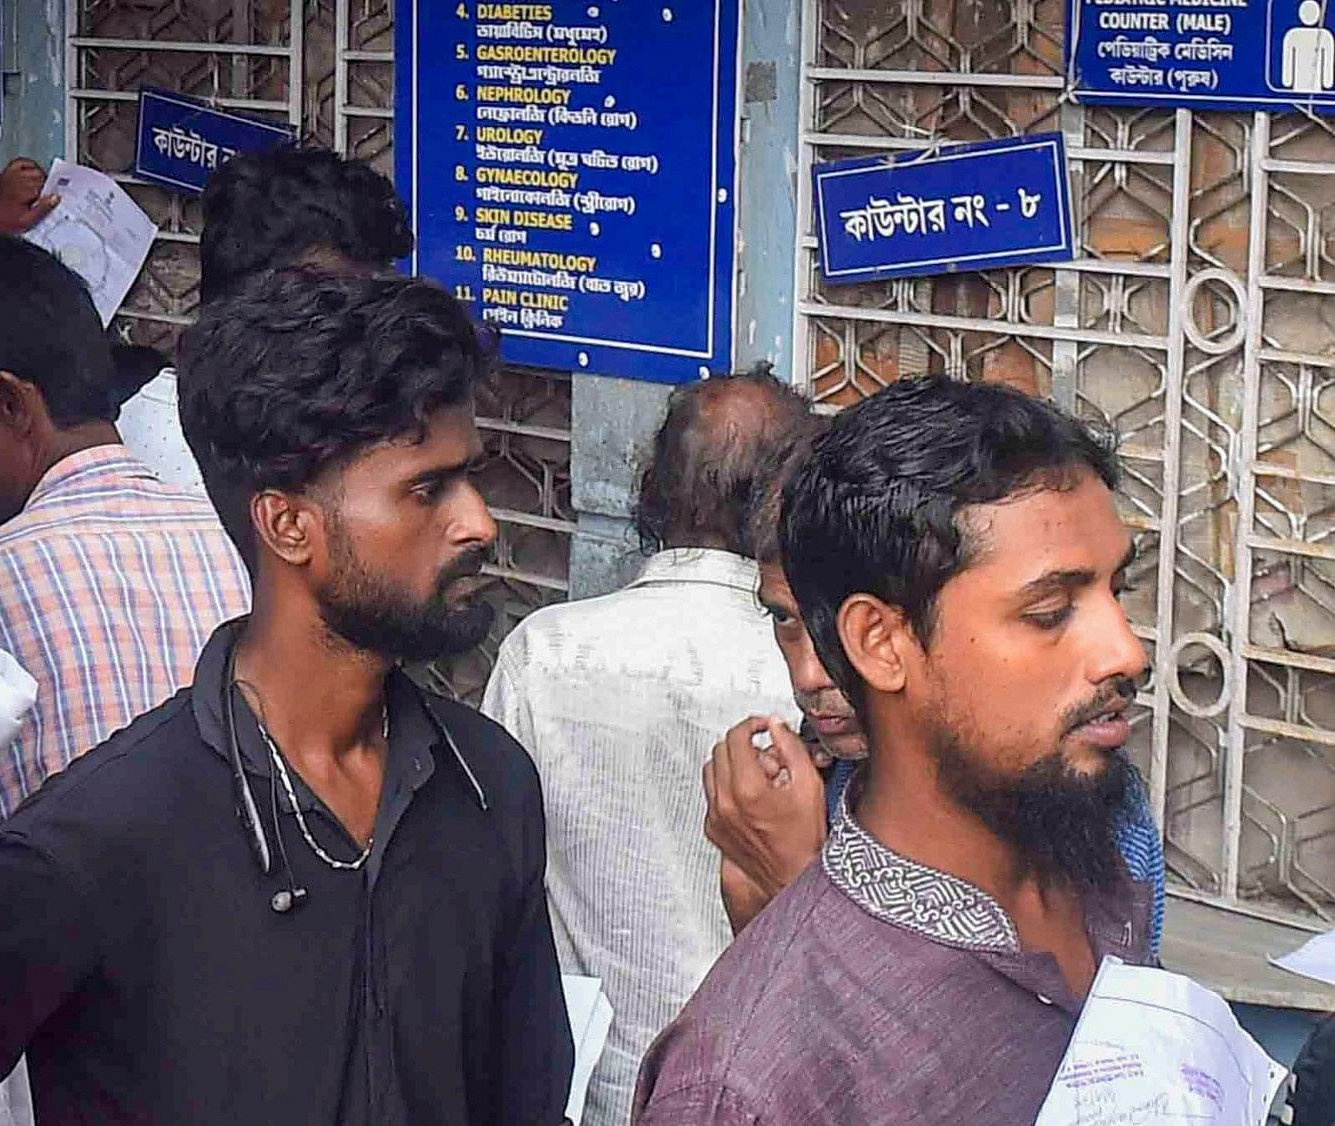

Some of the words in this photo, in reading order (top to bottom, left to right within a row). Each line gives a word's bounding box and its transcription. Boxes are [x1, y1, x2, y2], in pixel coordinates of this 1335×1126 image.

[457, 4, 469, 17] 4.
[478, 4, 551, 22] DIABETIES
[1100, 12, 1169, 29] COUNTER
[1177, 14, 1230, 35] (MALE)
[457, 45, 468, 58] 5.
[477, 45, 616, 65] GASROENTEROLOGY
[1175, 38, 1233, 60] মেডিসিন
[1109, 65, 1163, 85] কাউন্টার
[1168, 69, 1218, 91] (পুরুষ)
[456, 85, 468, 99] 6.
[477, 86, 571, 105] NEPHROLOGY
[457, 126, 468, 140] 7.
[476, 127, 542, 145] UROLOGY
[151, 126, 218, 169] কাউন্টার
[456, 166, 468, 180] 8.
[476, 166, 577, 189] GYNAECOLOGY
[456, 206, 468, 220] 9.
[476, 208, 510, 225] SKIN
[512, 211, 572, 231] DISEASE
[840, 193, 945, 241] কাউন্টার
[951, 195, 989, 227] নং
[1018, 189, 1040, 217] ৮
[456, 246, 476, 261] 10.
[482, 248, 595, 273] RHEUMATOLOGY
[456, 286, 475, 300] 11.
[483, 288, 516, 307] PAIN
[520, 292, 568, 313] CLINIC
